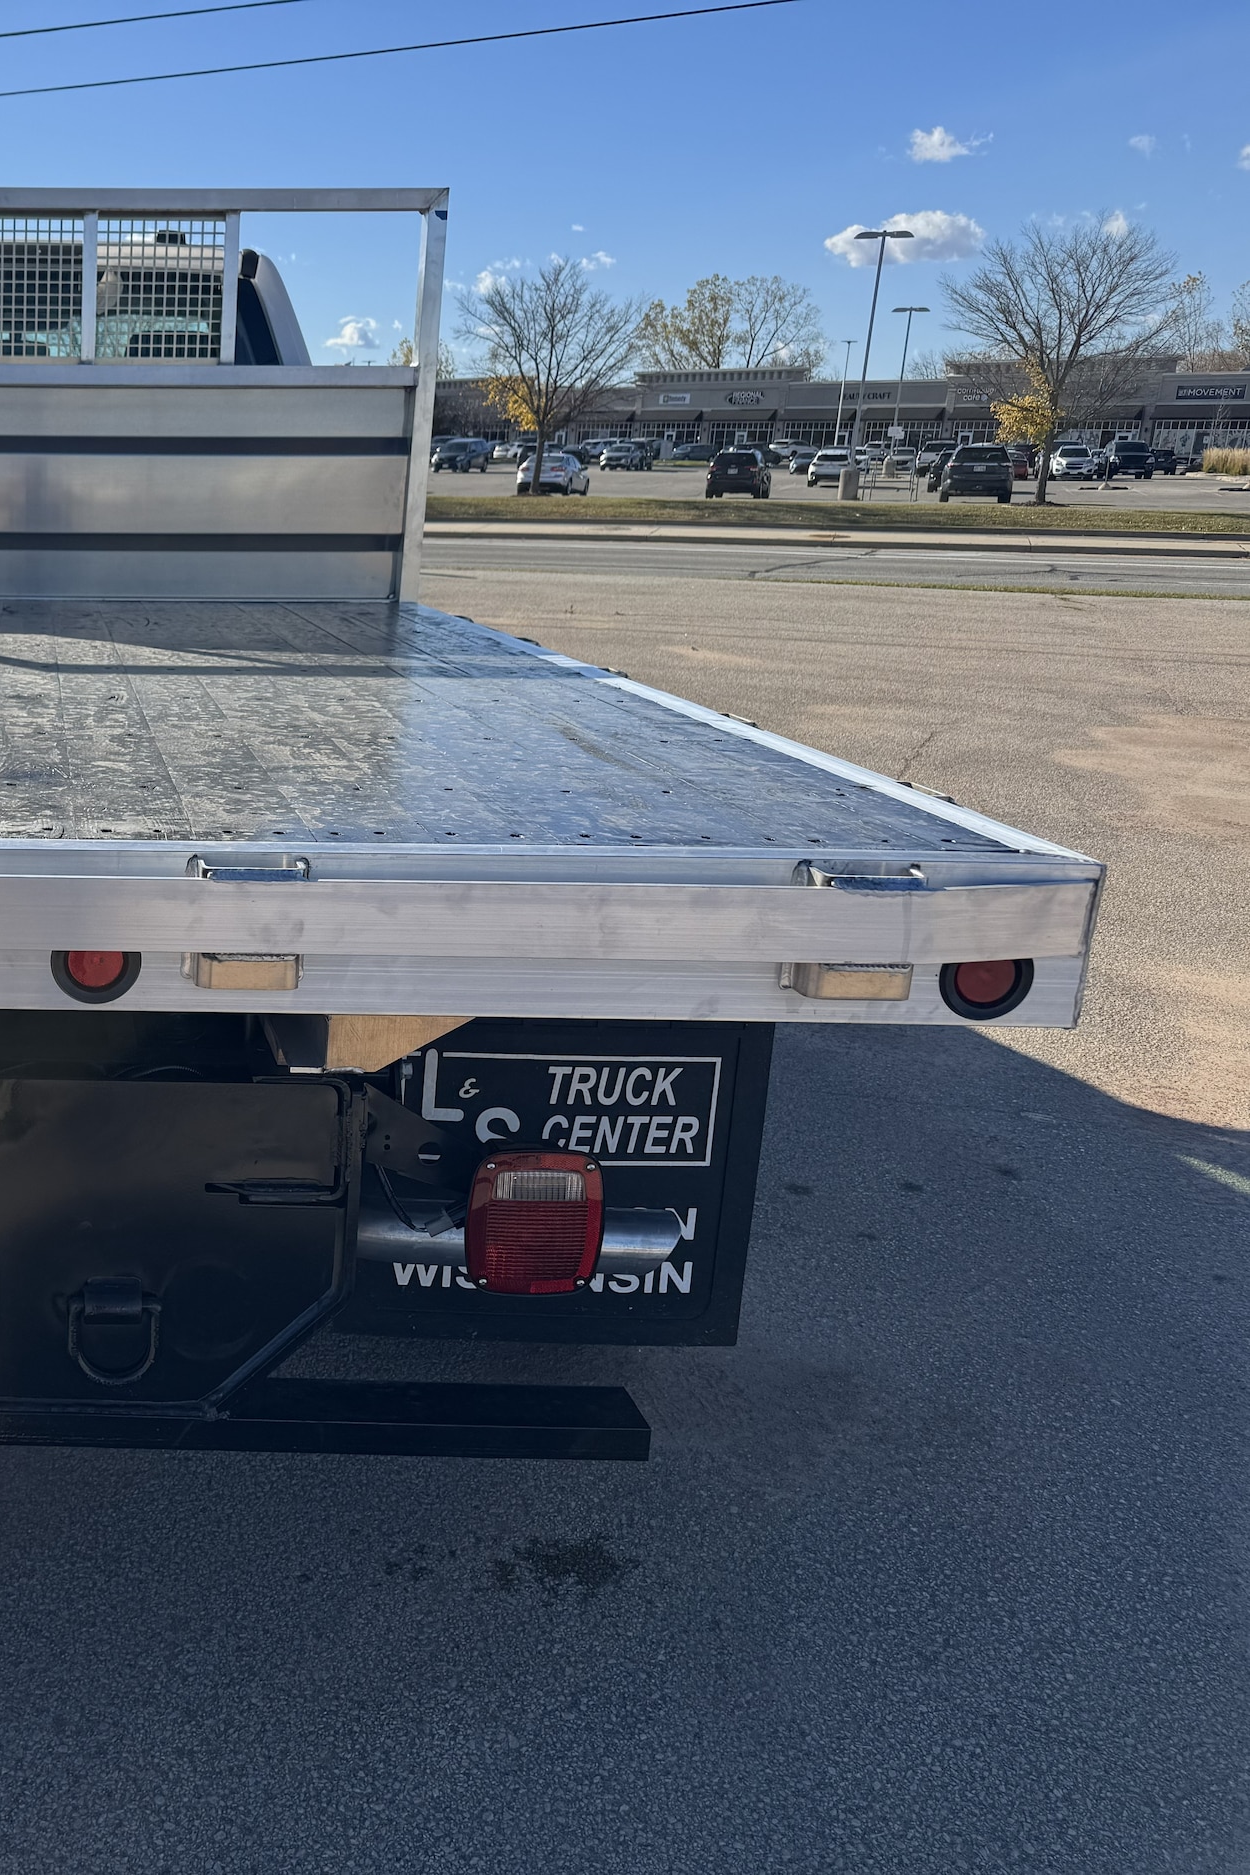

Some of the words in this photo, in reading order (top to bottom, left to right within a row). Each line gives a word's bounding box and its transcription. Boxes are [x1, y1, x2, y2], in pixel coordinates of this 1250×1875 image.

[839, 392, 867, 400] EAUY
[1187, 388, 1242, 396] MOVEMENT
[547, 1066, 684, 1106] TRUCK
[541, 1114, 700, 1154] CENTER
